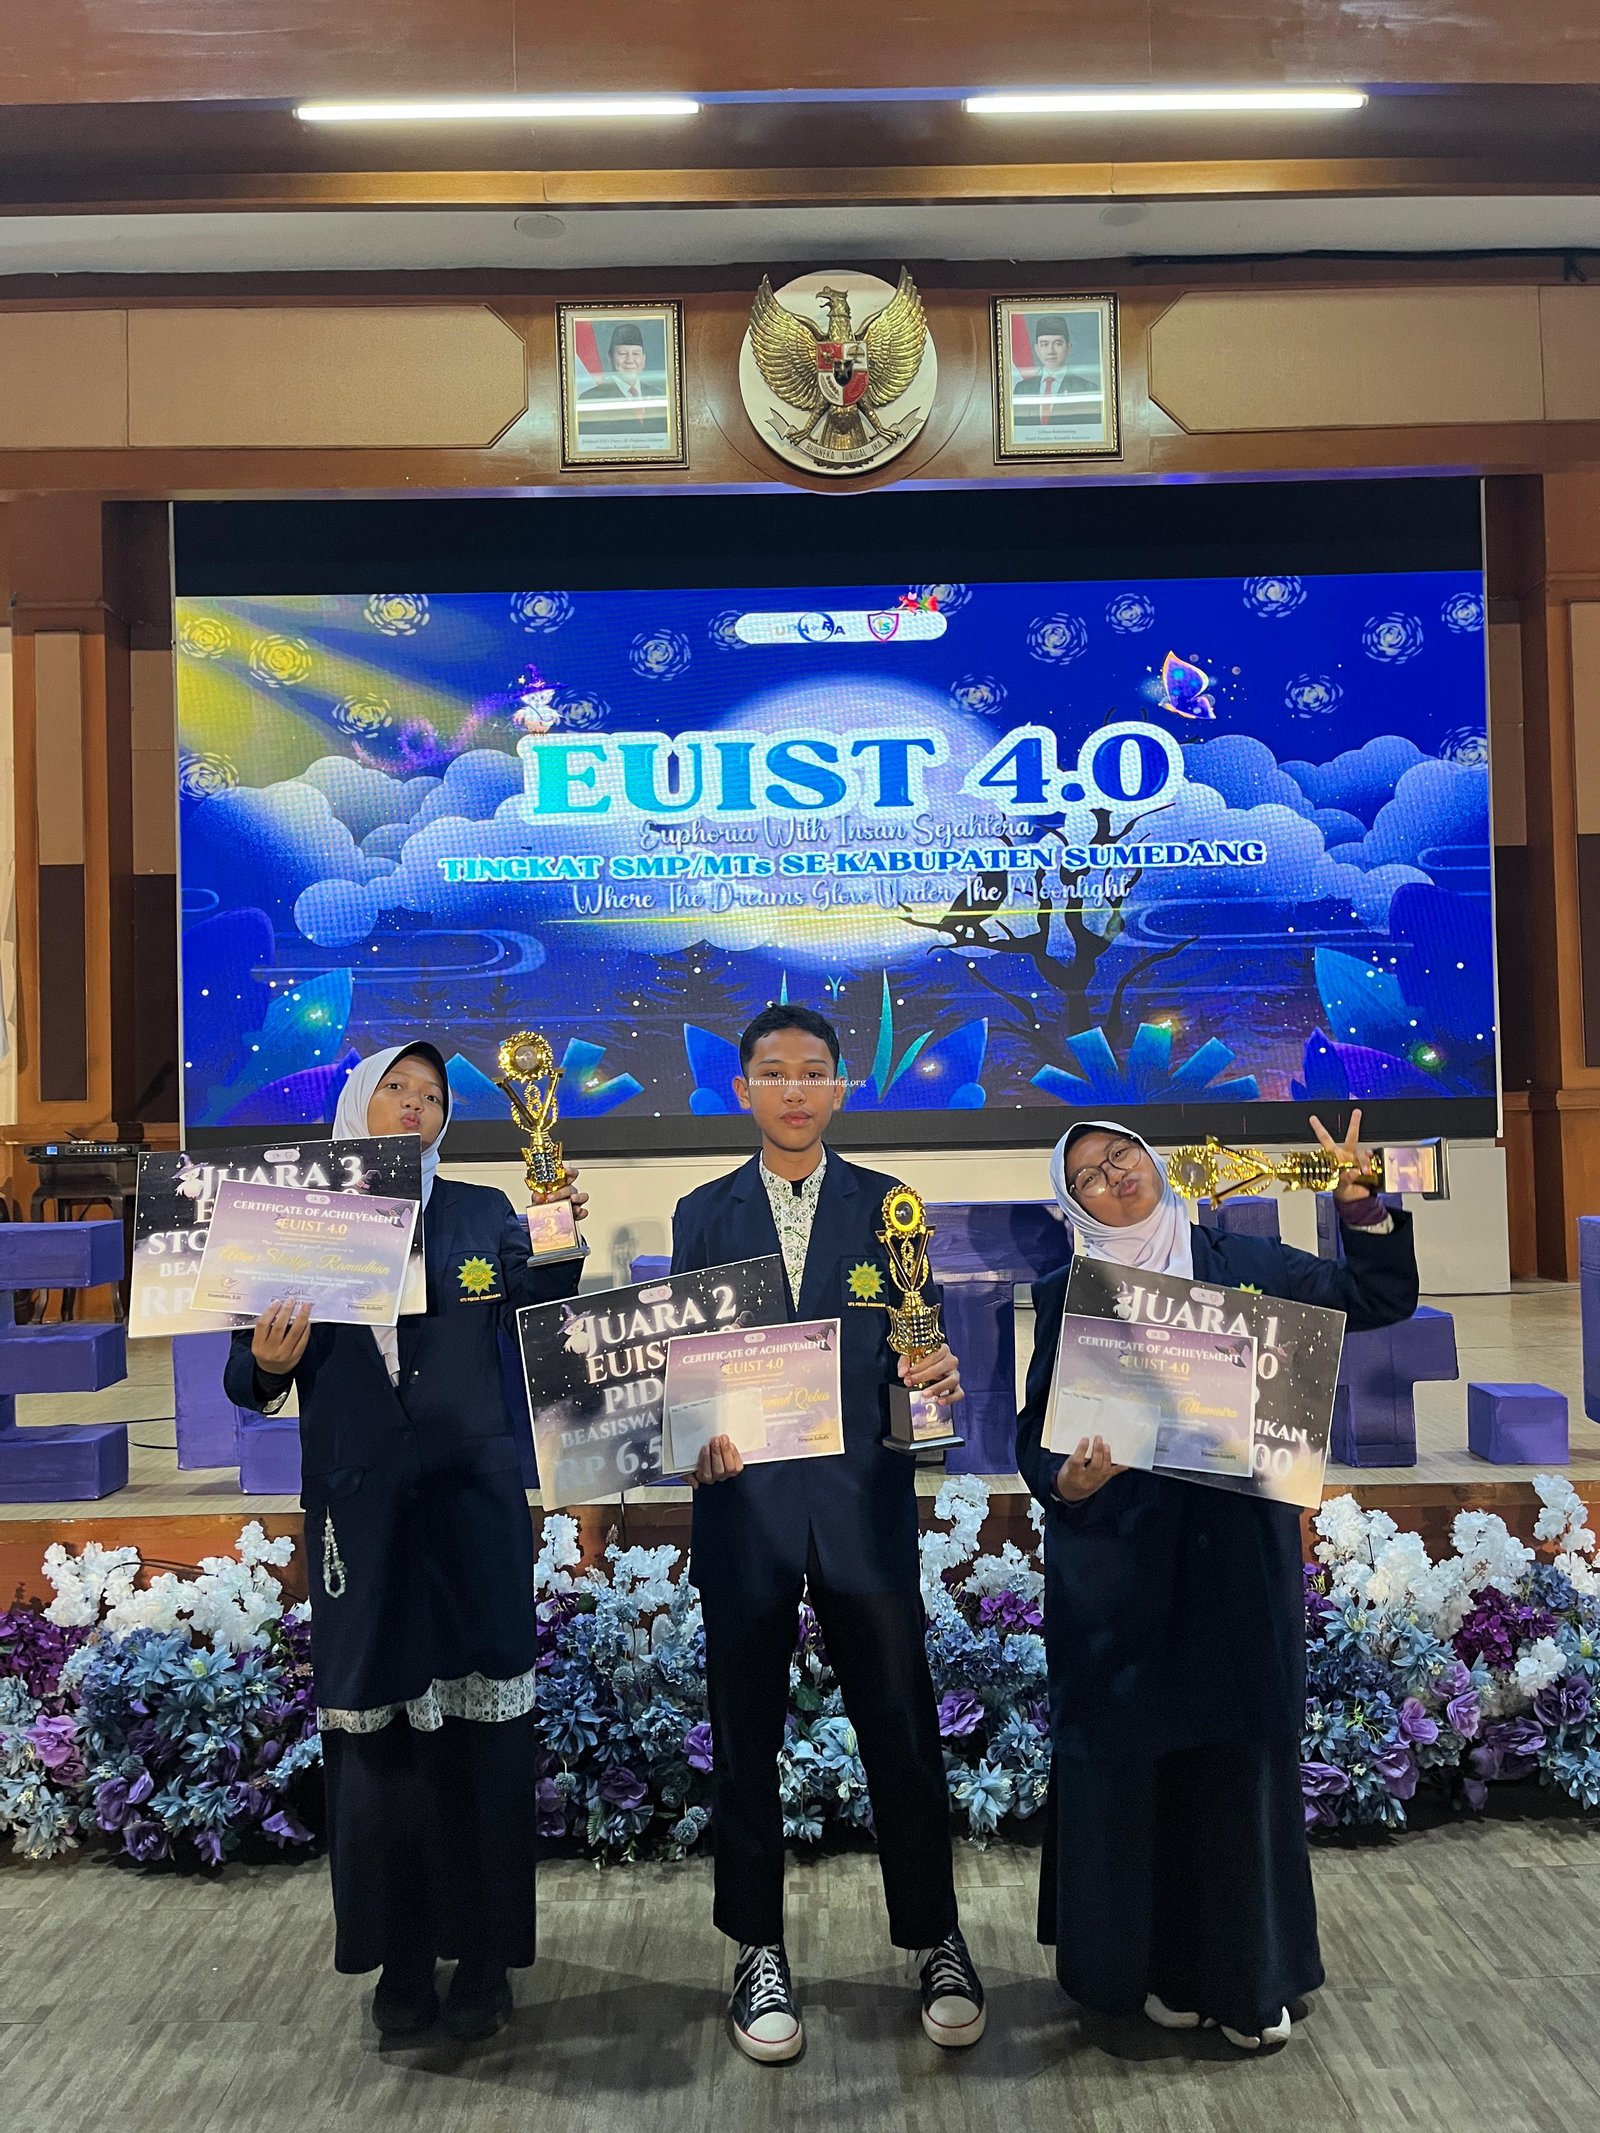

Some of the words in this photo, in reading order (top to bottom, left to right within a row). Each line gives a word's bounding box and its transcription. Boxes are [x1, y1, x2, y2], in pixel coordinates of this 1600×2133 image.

[526, 735, 941, 819] EUIST
[971, 728, 1177, 808] 4.0
[640, 819, 758, 852] Euphoria
[764, 815, 831, 847] With
[836, 814, 907, 847] Insan
[913, 813, 1034, 848] Sejahtera
[439, 856, 605, 882] TINGKAT
[611, 852, 773, 879] SMP/MTs
[781, 847, 1057, 877] SE-KABUPATEN
[1063, 841, 1267, 870] SUMEDANG
[572, 883, 656, 915] Where
[670, 882, 706, 913] The
[709, 881, 804, 913] Dreams
[812, 880, 868, 911] Glow
[876, 876, 957, 908] Under
[967, 874, 1002, 907] The
[1007, 872, 1132, 908] Moonlight
[340, 1156, 363, 1188] 3
[233, 1200, 303, 1216] CERTIFICATE
[306, 1207, 320, 1217] OF
[322, 1208, 401, 1226] ACHIEVEMENT
[280, 1218, 325, 1233] EUIST
[327, 1223, 347, 1235] 4.0
[544, 1216, 557, 1237] 3
[585, 1297, 707, 1358] JUARA
[712, 1286, 737, 1320] 2
[1127, 1285, 1250, 1338] JUARA
[1263, 1316, 1279, 1347] 1
[683, 1348, 743, 1364] CERTIFICATE
[745, 1347, 758, 1357] OF
[760, 1340, 827, 1356] ACHIEVEMENT
[1078, 1335, 1145, 1351] CERTIFICATE
[1146, 1344, 1160, 1354] OF
[1162, 1346, 1241, 1364] ACHIEVEMENT
[726, 1359, 763, 1375] EUIST
[766, 1358, 784, 1370] 4.0
[1125, 1355, 1167, 1371] EUIST
[1169, 1361, 1190, 1375] 4.0
[925, 1403, 938, 1423] 2
[561, 1412, 659, 1449] BEASISWA
